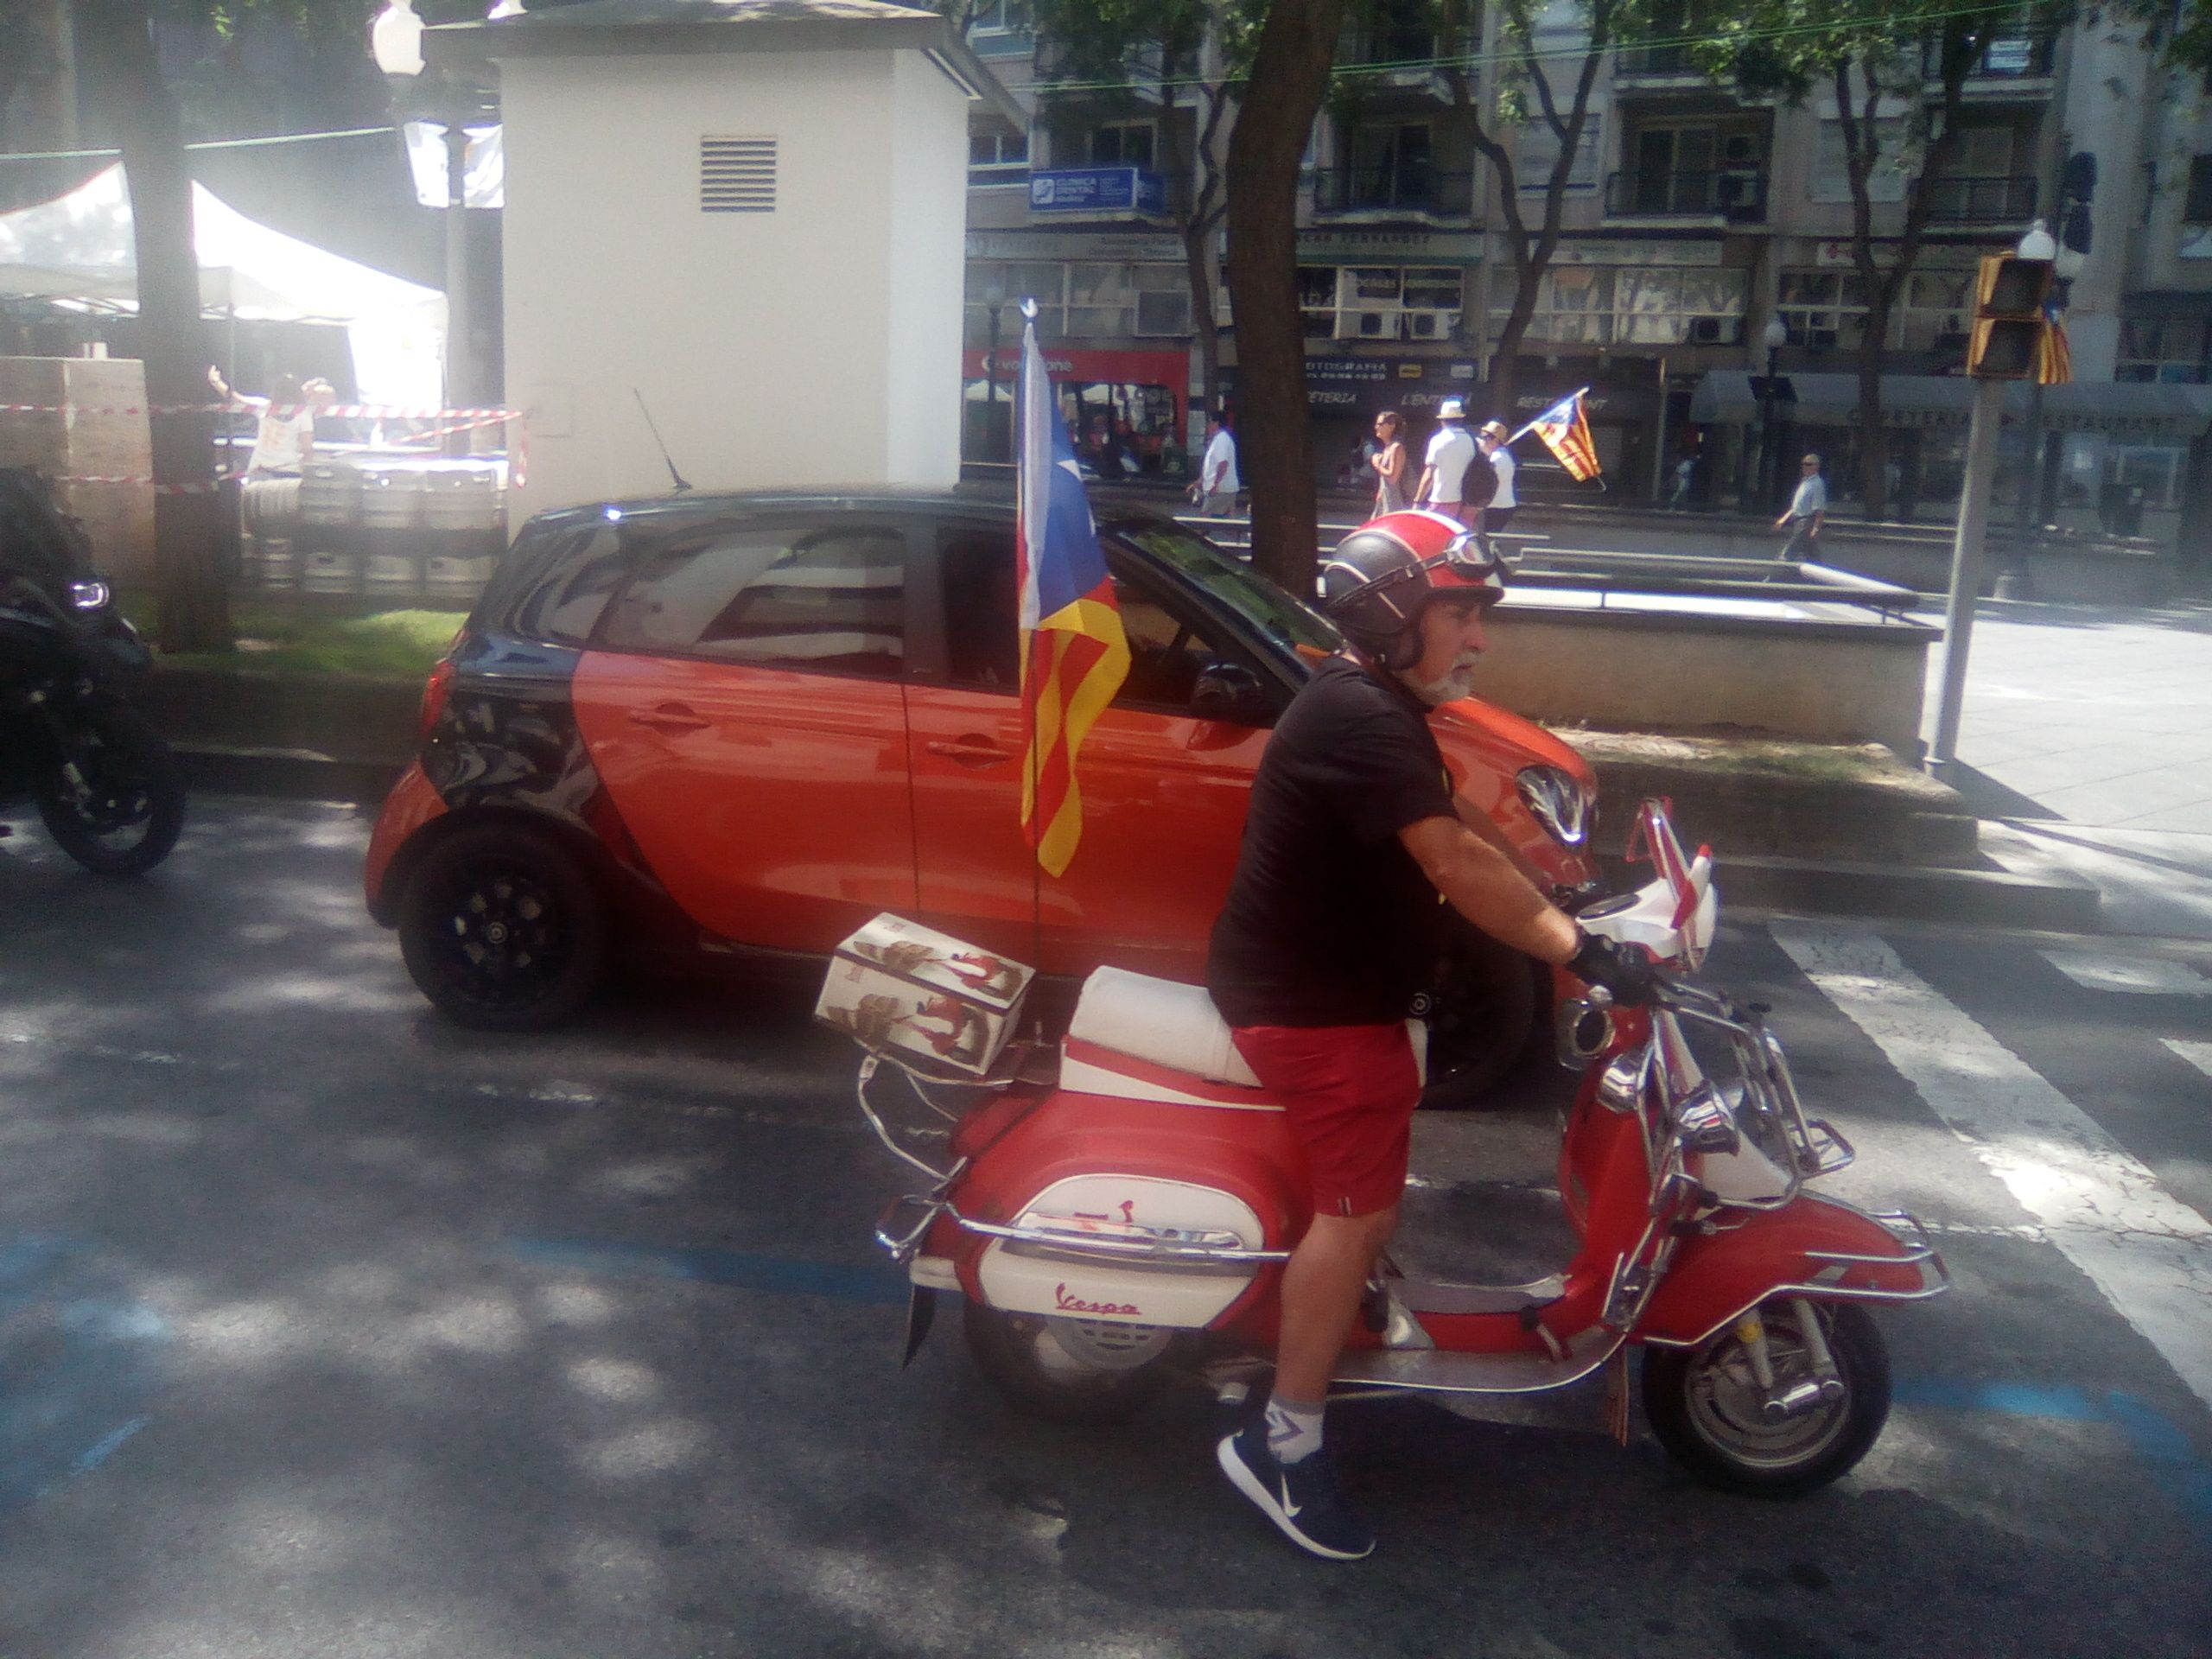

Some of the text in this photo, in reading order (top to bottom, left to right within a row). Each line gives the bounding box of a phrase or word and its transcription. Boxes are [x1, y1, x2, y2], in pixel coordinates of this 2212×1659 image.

[1001, 359, 1074, 372] voone
[1305, 361, 1388, 372] OTOGRAFIA
[1055, 1282, 1142, 1315] Vespa
